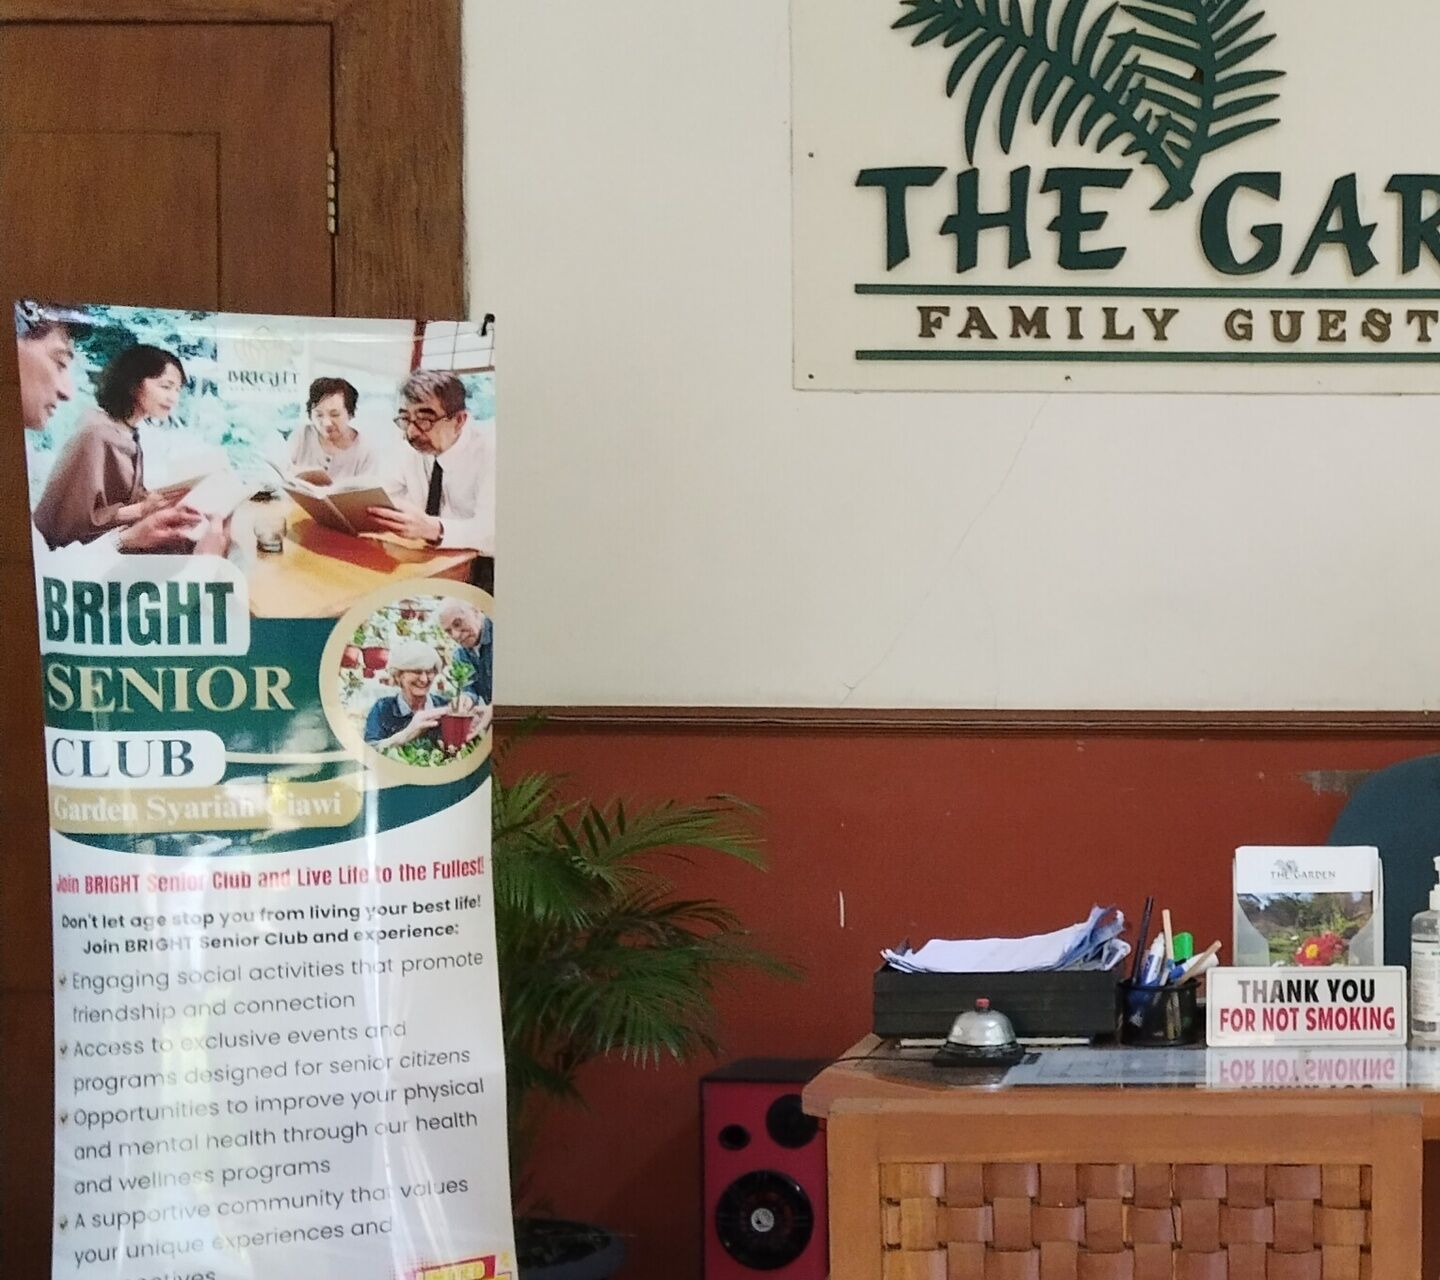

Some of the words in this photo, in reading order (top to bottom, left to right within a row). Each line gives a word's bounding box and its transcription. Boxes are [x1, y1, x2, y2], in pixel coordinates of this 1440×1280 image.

[855, 164, 1133, 273] THE
[916, 304, 1181, 340] FAMILY
[1223, 307, 1440, 342] GUEST
[43, 577, 234, 646] BRIGHT
[46, 663, 296, 714] SENIOR
[51, 737, 195, 778] CLUB
[54, 795, 137, 822] Garden
[147, 794, 256, 825] Syariah
[56, 874, 79, 894] Join
[85, 873, 140, 894] BRIGHT
[147, 872, 205, 893] Senior
[212, 870, 251, 890] Club
[258, 868, 291, 888] and
[297, 866, 332, 887] Live
[339, 864, 369, 885] Life
[377, 865, 392, 884] to
[400, 863, 427, 882] the
[432, 856, 486, 880] Fullest!
[1271, 871, 1290, 879] THE
[1294, 870, 1336, 879] GARDEN
[62, 913, 98, 929] Don't
[102, 914, 125, 929] let
[130, 915, 166, 932] age
[172, 913, 215, 930] stop
[219, 910, 255, 929] you
[260, 907, 305, 921] from
[310, 905, 361, 922] living
[365, 902, 408, 921] your
[413, 897, 451, 915] best
[455, 894, 482, 911] life!
[83, 940, 120, 955] Join
[125, 936, 193, 954] BRIGHT
[200, 933, 259, 949] Senior
[265, 929, 308, 946] Club
[313, 929, 349, 944] and
[354, 924, 460, 945] experience:
[72, 971, 170, 995] Engaging
[177, 966, 242, 985] social
[249, 961, 345, 982] activities
[352, 959, 394, 976] that
[401, 951, 484, 977] promote
[1238, 979, 1319, 1004] THANK
[1327, 978, 1376, 1004] YOU
[73, 1002, 176, 1024] friendship
[183, 1000, 226, 1018] and
[234, 992, 356, 1015] connection
[1219, 1008, 1256, 1032] FOR
[1262, 1007, 1300, 1031] NOT
[1305, 1006, 1396, 1031] SMOKING
[73, 1039, 145, 1058] Access
[152, 1037, 173, 1054] to
[180, 1031, 281, 1053] exclusive
[288, 1025, 359, 1045] events
[365, 1022, 407, 1039] and
[73, 1072, 177, 1096] programs
[185, 1062, 287, 1087] designed
[295, 1062, 324, 1077] for
[329, 1056, 394, 1074] senior
[400, 1048, 471, 1069] citizens
[74, 1101, 220, 1130] Opportunities
[227, 1099, 248, 1114] to
[255, 1092, 345, 1115] improve
[351, 1088, 398, 1109] your
[404, 1078, 485, 1105] physical
[74, 1141, 111, 1160] and
[119, 1134, 199, 1157] mental
[206, 1128, 276, 1149] health
[284, 1122, 368, 1144] through
[375, 1121, 410, 1136] our
[416, 1111, 478, 1132] health
[74, 1176, 112, 1195] and
[119, 1169, 214, 1191] wellness
[222, 1159, 331, 1185] programs
[74, 1213, 86, 1229] A
[91, 1203, 210, 1230] supportive
[217, 1189, 345, 1215] community
[400, 1178, 469, 1198] values
[74, 1247, 119, 1269] your
[126, 1239, 204, 1260] unique
[212, 1223, 345, 1250] experiences
[351, 1217, 393, 1236] and
